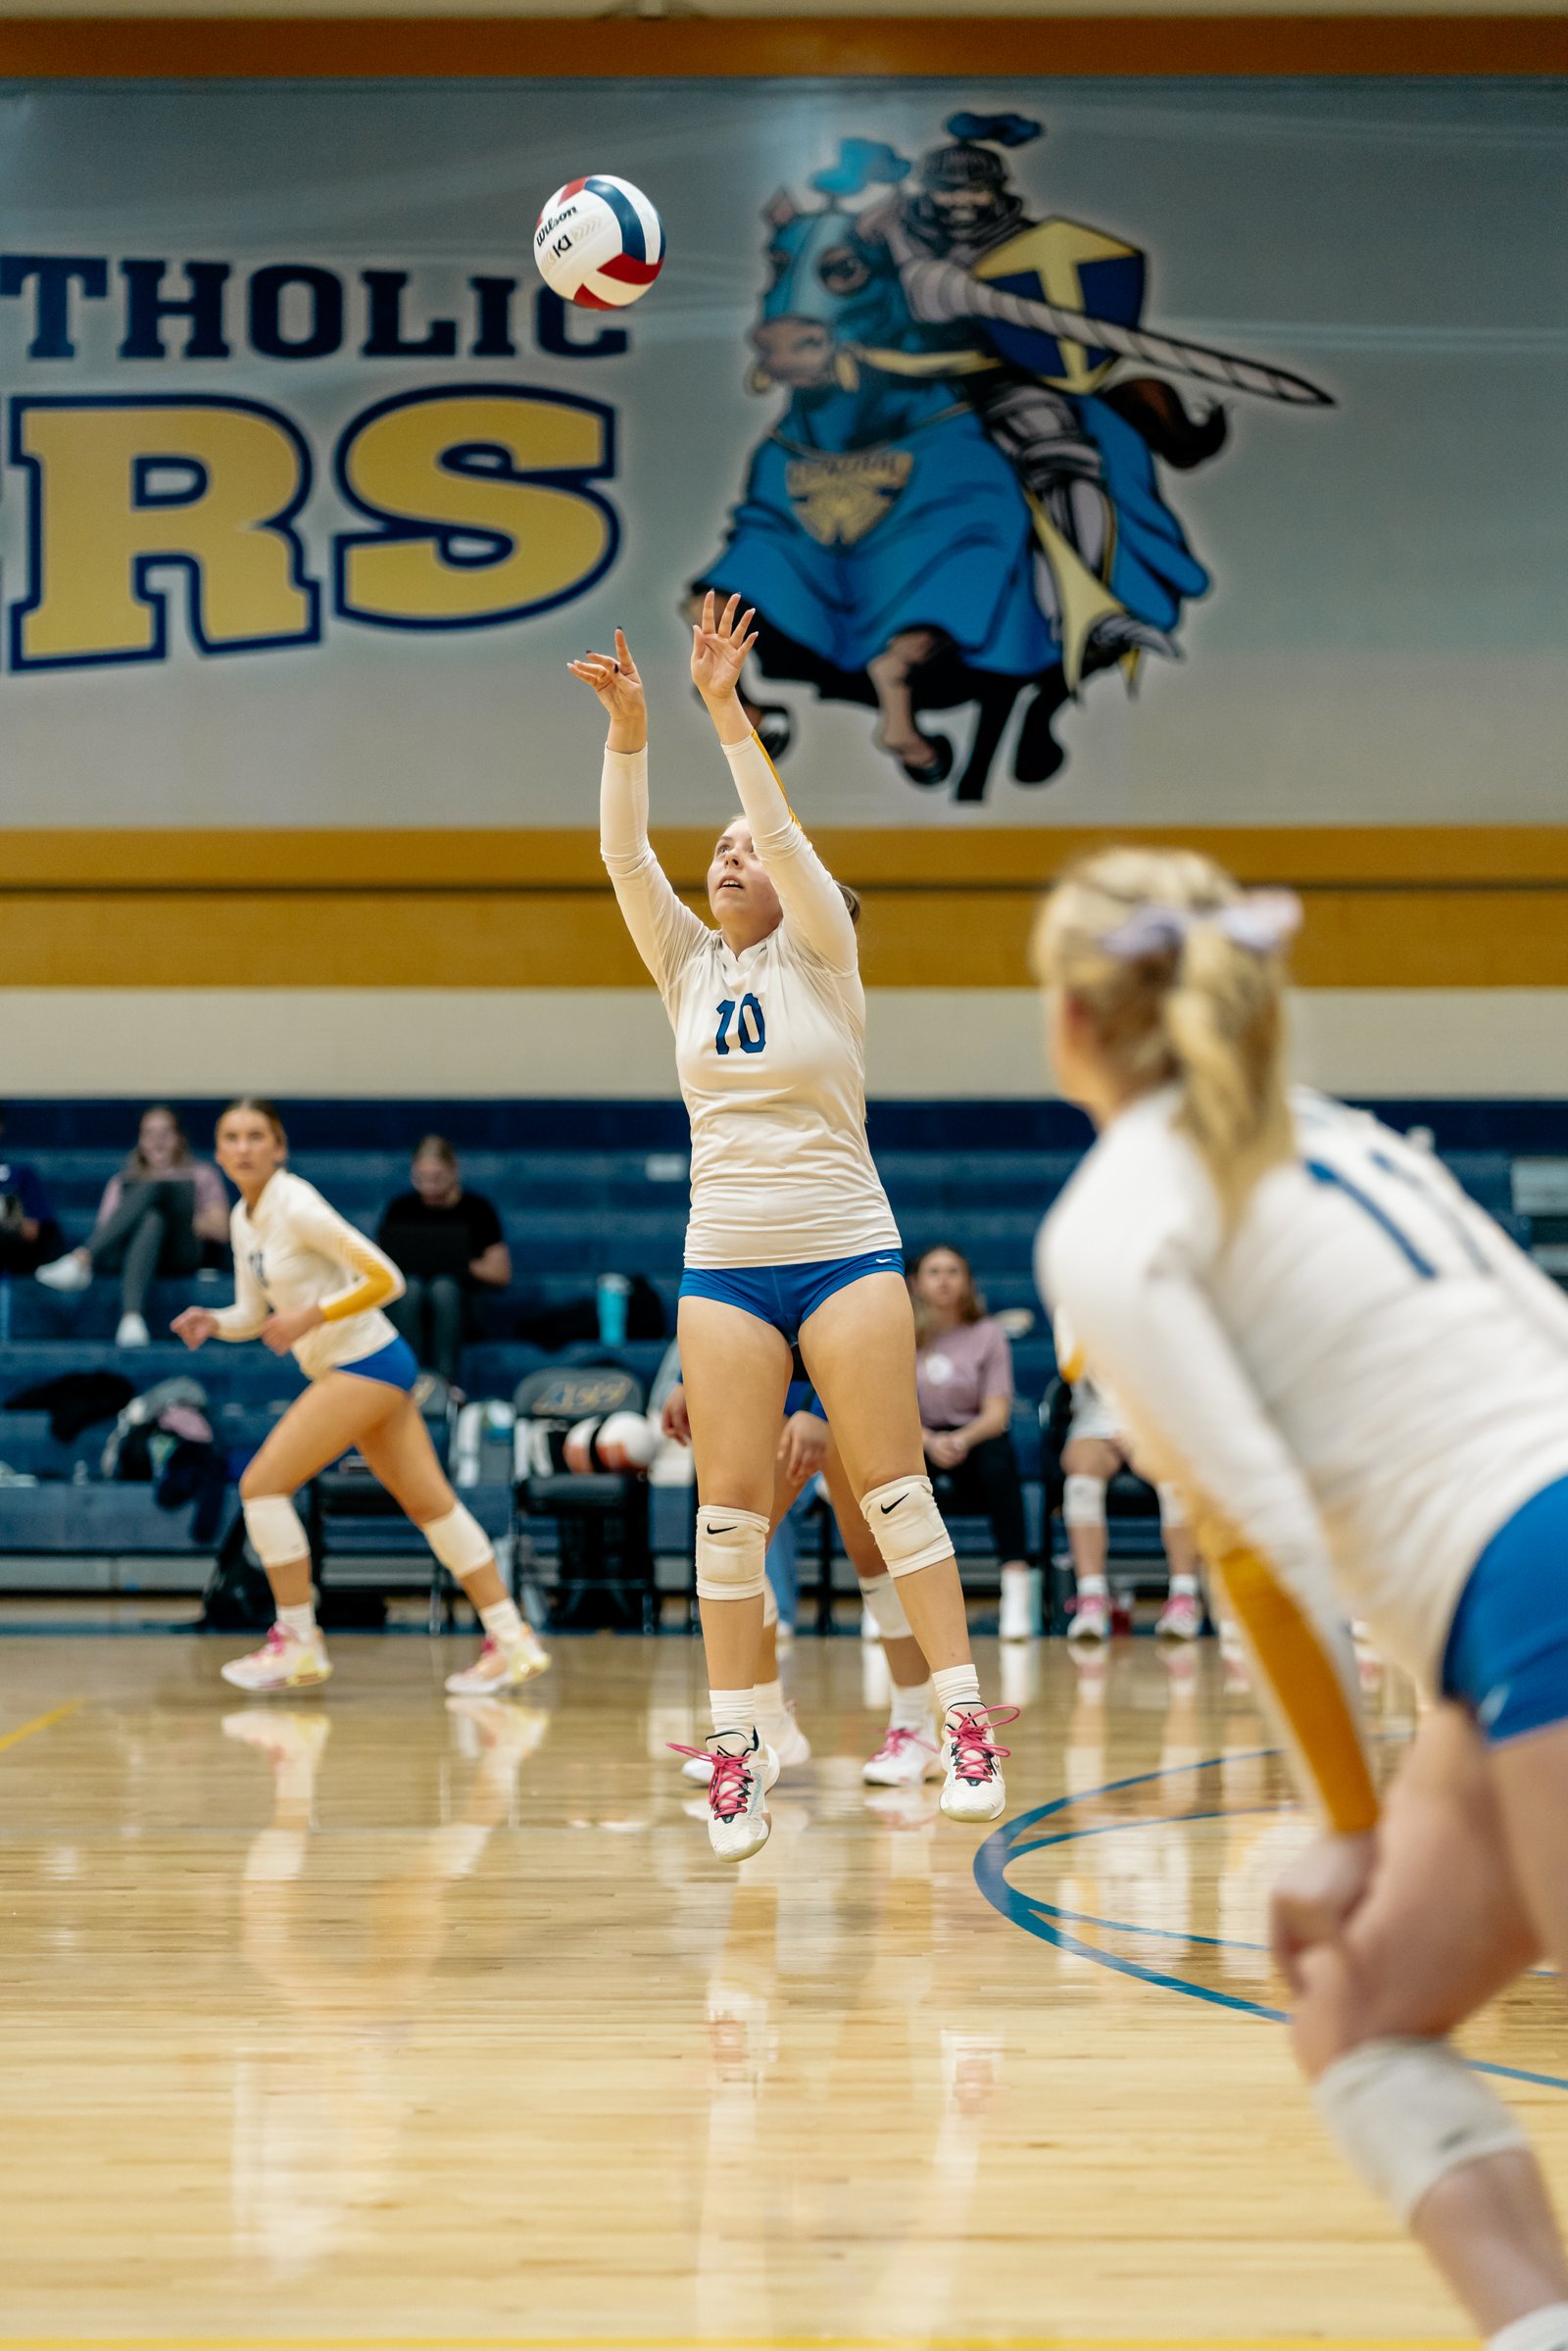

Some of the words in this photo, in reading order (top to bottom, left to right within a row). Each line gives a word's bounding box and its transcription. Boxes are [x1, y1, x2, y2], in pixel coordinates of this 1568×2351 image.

[536, 205, 578, 248] Wilson
[0, 383, 621, 673] RS
[715, 992, 766, 1055] 10
